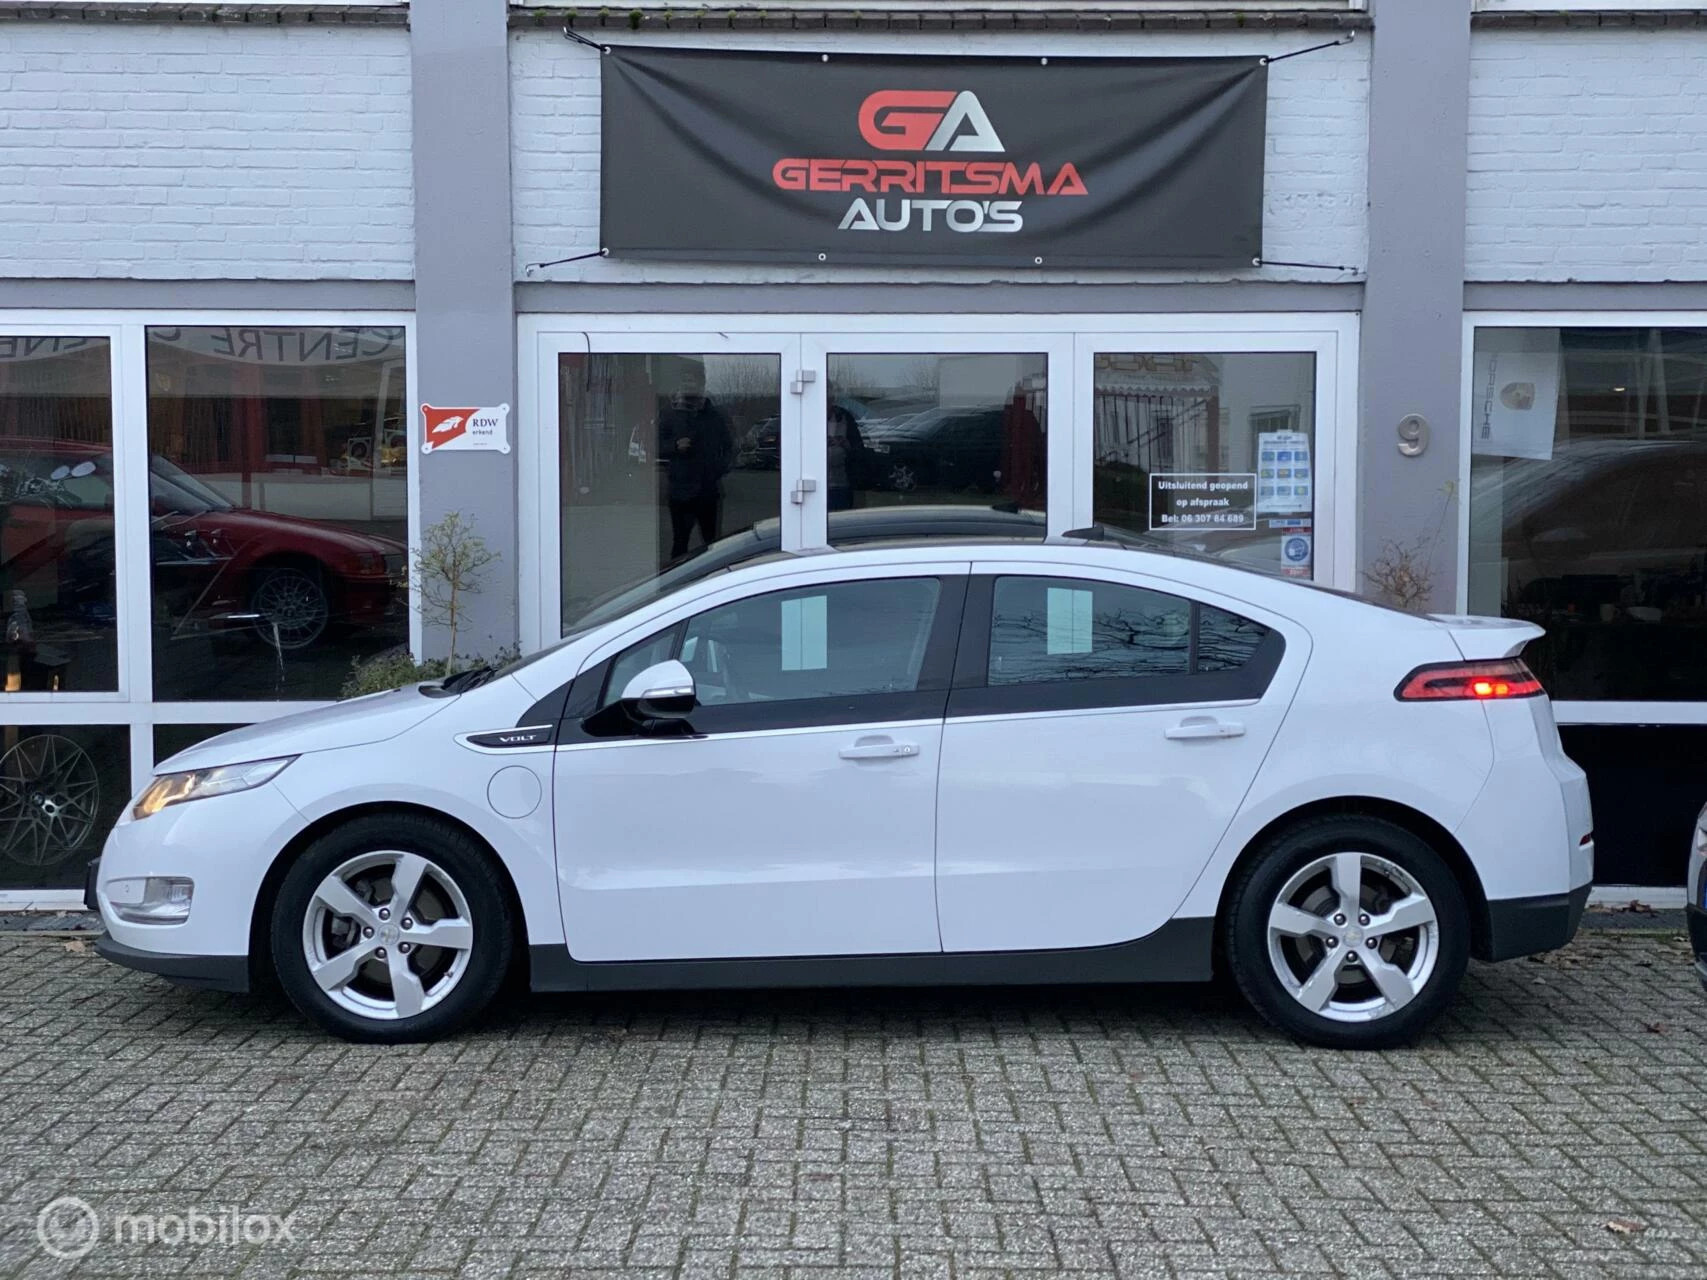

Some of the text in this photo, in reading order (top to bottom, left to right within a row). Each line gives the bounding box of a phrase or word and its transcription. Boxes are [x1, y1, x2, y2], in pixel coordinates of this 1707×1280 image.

[858, 90, 1006, 152] GA
[772, 158, 1089, 195] GERRITSMA
[838, 197, 1024, 233] AUTO'S
[472, 418, 498, 427] RDW
[1398, 413, 1431, 458] 9
[1158, 481, 1248, 492] Uitsluitend geopend
[1176, 497, 1230, 508] op afspraak
[1161, 514, 1179, 523] Bel:
[1181, 514, 1193, 523] 06
[1194, 514, 1211, 523] 307
[499, 734, 536, 743] VOLT
